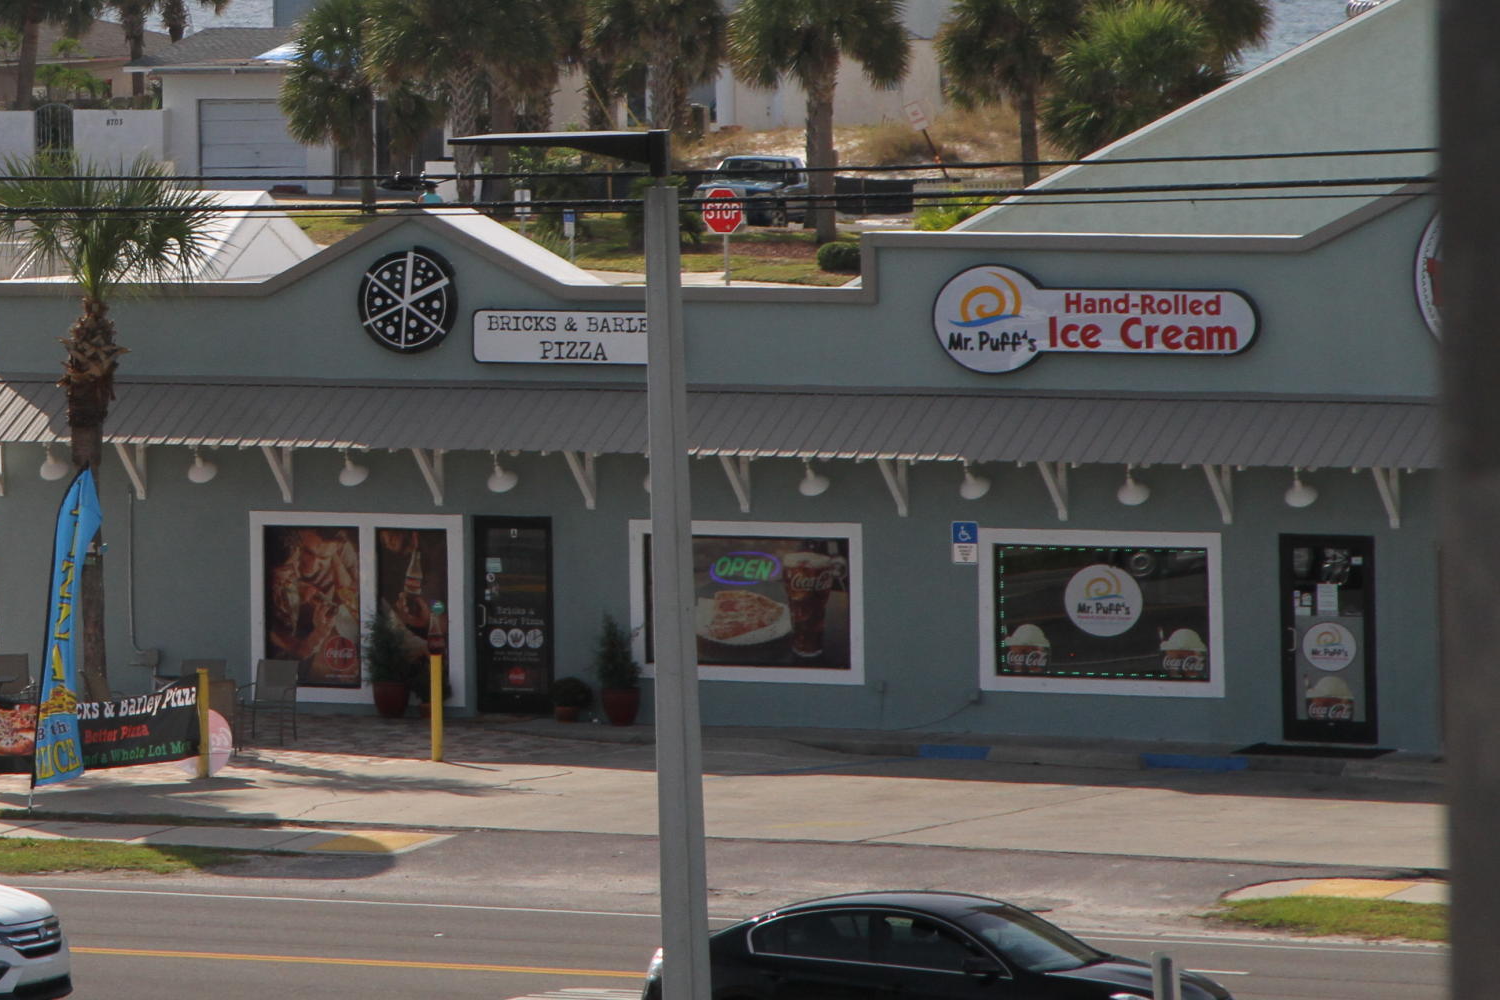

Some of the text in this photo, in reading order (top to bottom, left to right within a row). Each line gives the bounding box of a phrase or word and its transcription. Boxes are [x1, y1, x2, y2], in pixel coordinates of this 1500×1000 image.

[706, 202, 739, 220] STOP
[1064, 293, 1222, 316] Hand-Rolled
[487, 315, 647, 333] BRICKS & BARLE
[1049, 316, 1238, 350] Ice Cream
[540, 341, 608, 361] PIZZA
[948, 330, 1037, 352] Mr. Puff's
[715, 556, 774, 580] OPEN
[1077, 602, 1131, 616] Mr. Puff's
[103, 701, 116, 719] &
[119, 695, 162, 717] Barley
[162, 686, 197, 709] Pizza
[120, 724, 150, 739] Pizza
[110, 747, 146, 762] Whole
[148, 743, 168, 757] Lot
